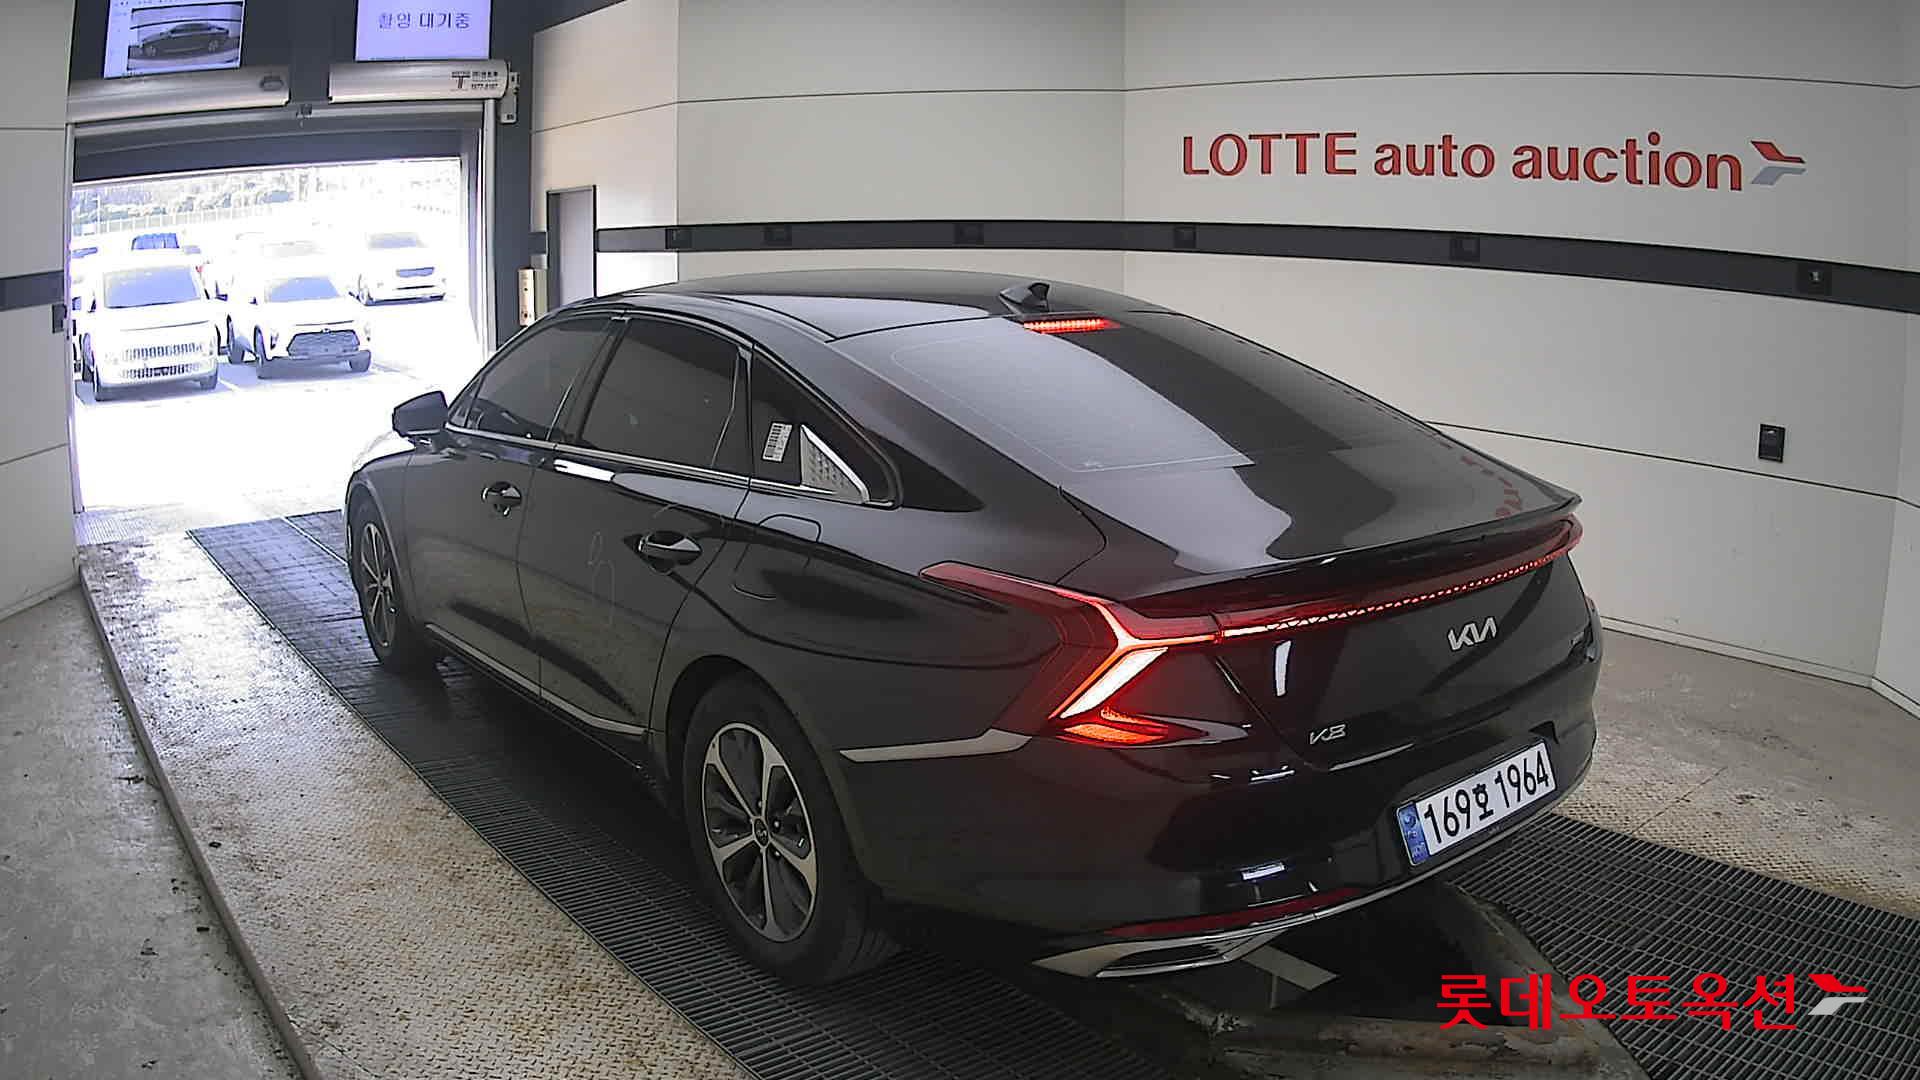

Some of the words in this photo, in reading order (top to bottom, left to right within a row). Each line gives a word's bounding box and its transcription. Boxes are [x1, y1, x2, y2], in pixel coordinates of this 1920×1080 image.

[419, 11, 471, 30] 대기중
[1184, 133, 1358, 178] LOTTE
[1375, 135, 1496, 178] auto
[1512, 132, 1742, 190] auction
[1448, 616, 1498, 651] KIA
[1309, 723, 1347, 745] K8
[1423, 783, 1495, 844] 169호
[1494, 750, 1550, 808] 1964
